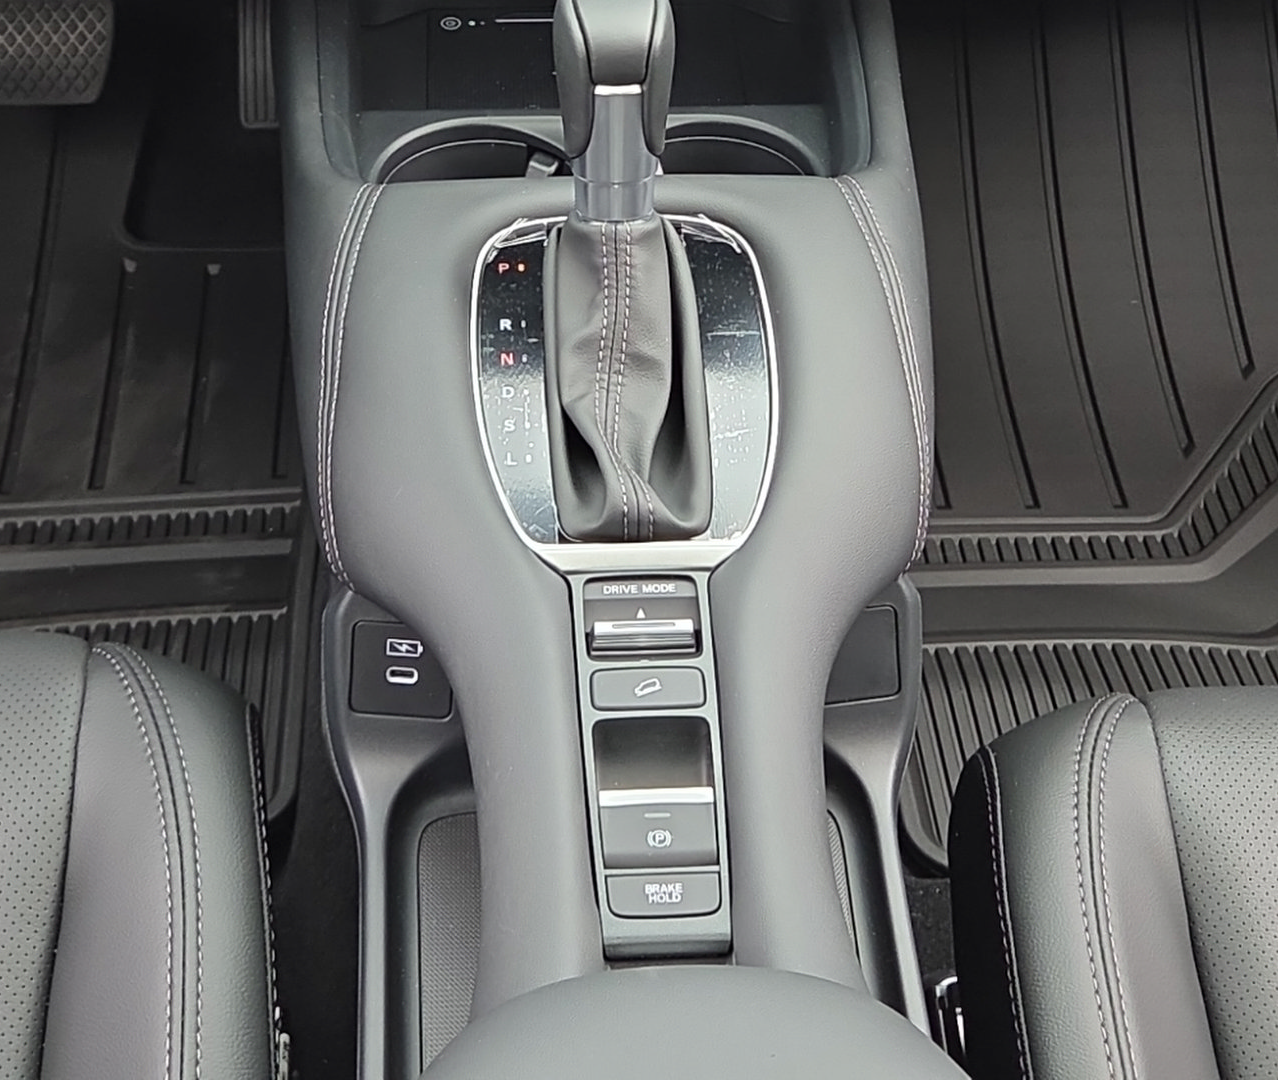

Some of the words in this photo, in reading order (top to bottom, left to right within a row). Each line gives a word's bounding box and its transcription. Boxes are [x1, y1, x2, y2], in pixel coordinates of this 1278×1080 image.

[498, 263, 510, 274] P
[499, 319, 512, 331] R
[500, 353, 514, 366] N
[501, 387, 514, 398] D
[504, 419, 516, 432] S
[506, 452, 518, 466] L
[603, 584, 639, 595] DRIVE
[642, 583, 676, 594] MODE
[645, 882, 683, 895] BRAKE
[648, 892, 682, 904] HOLD
